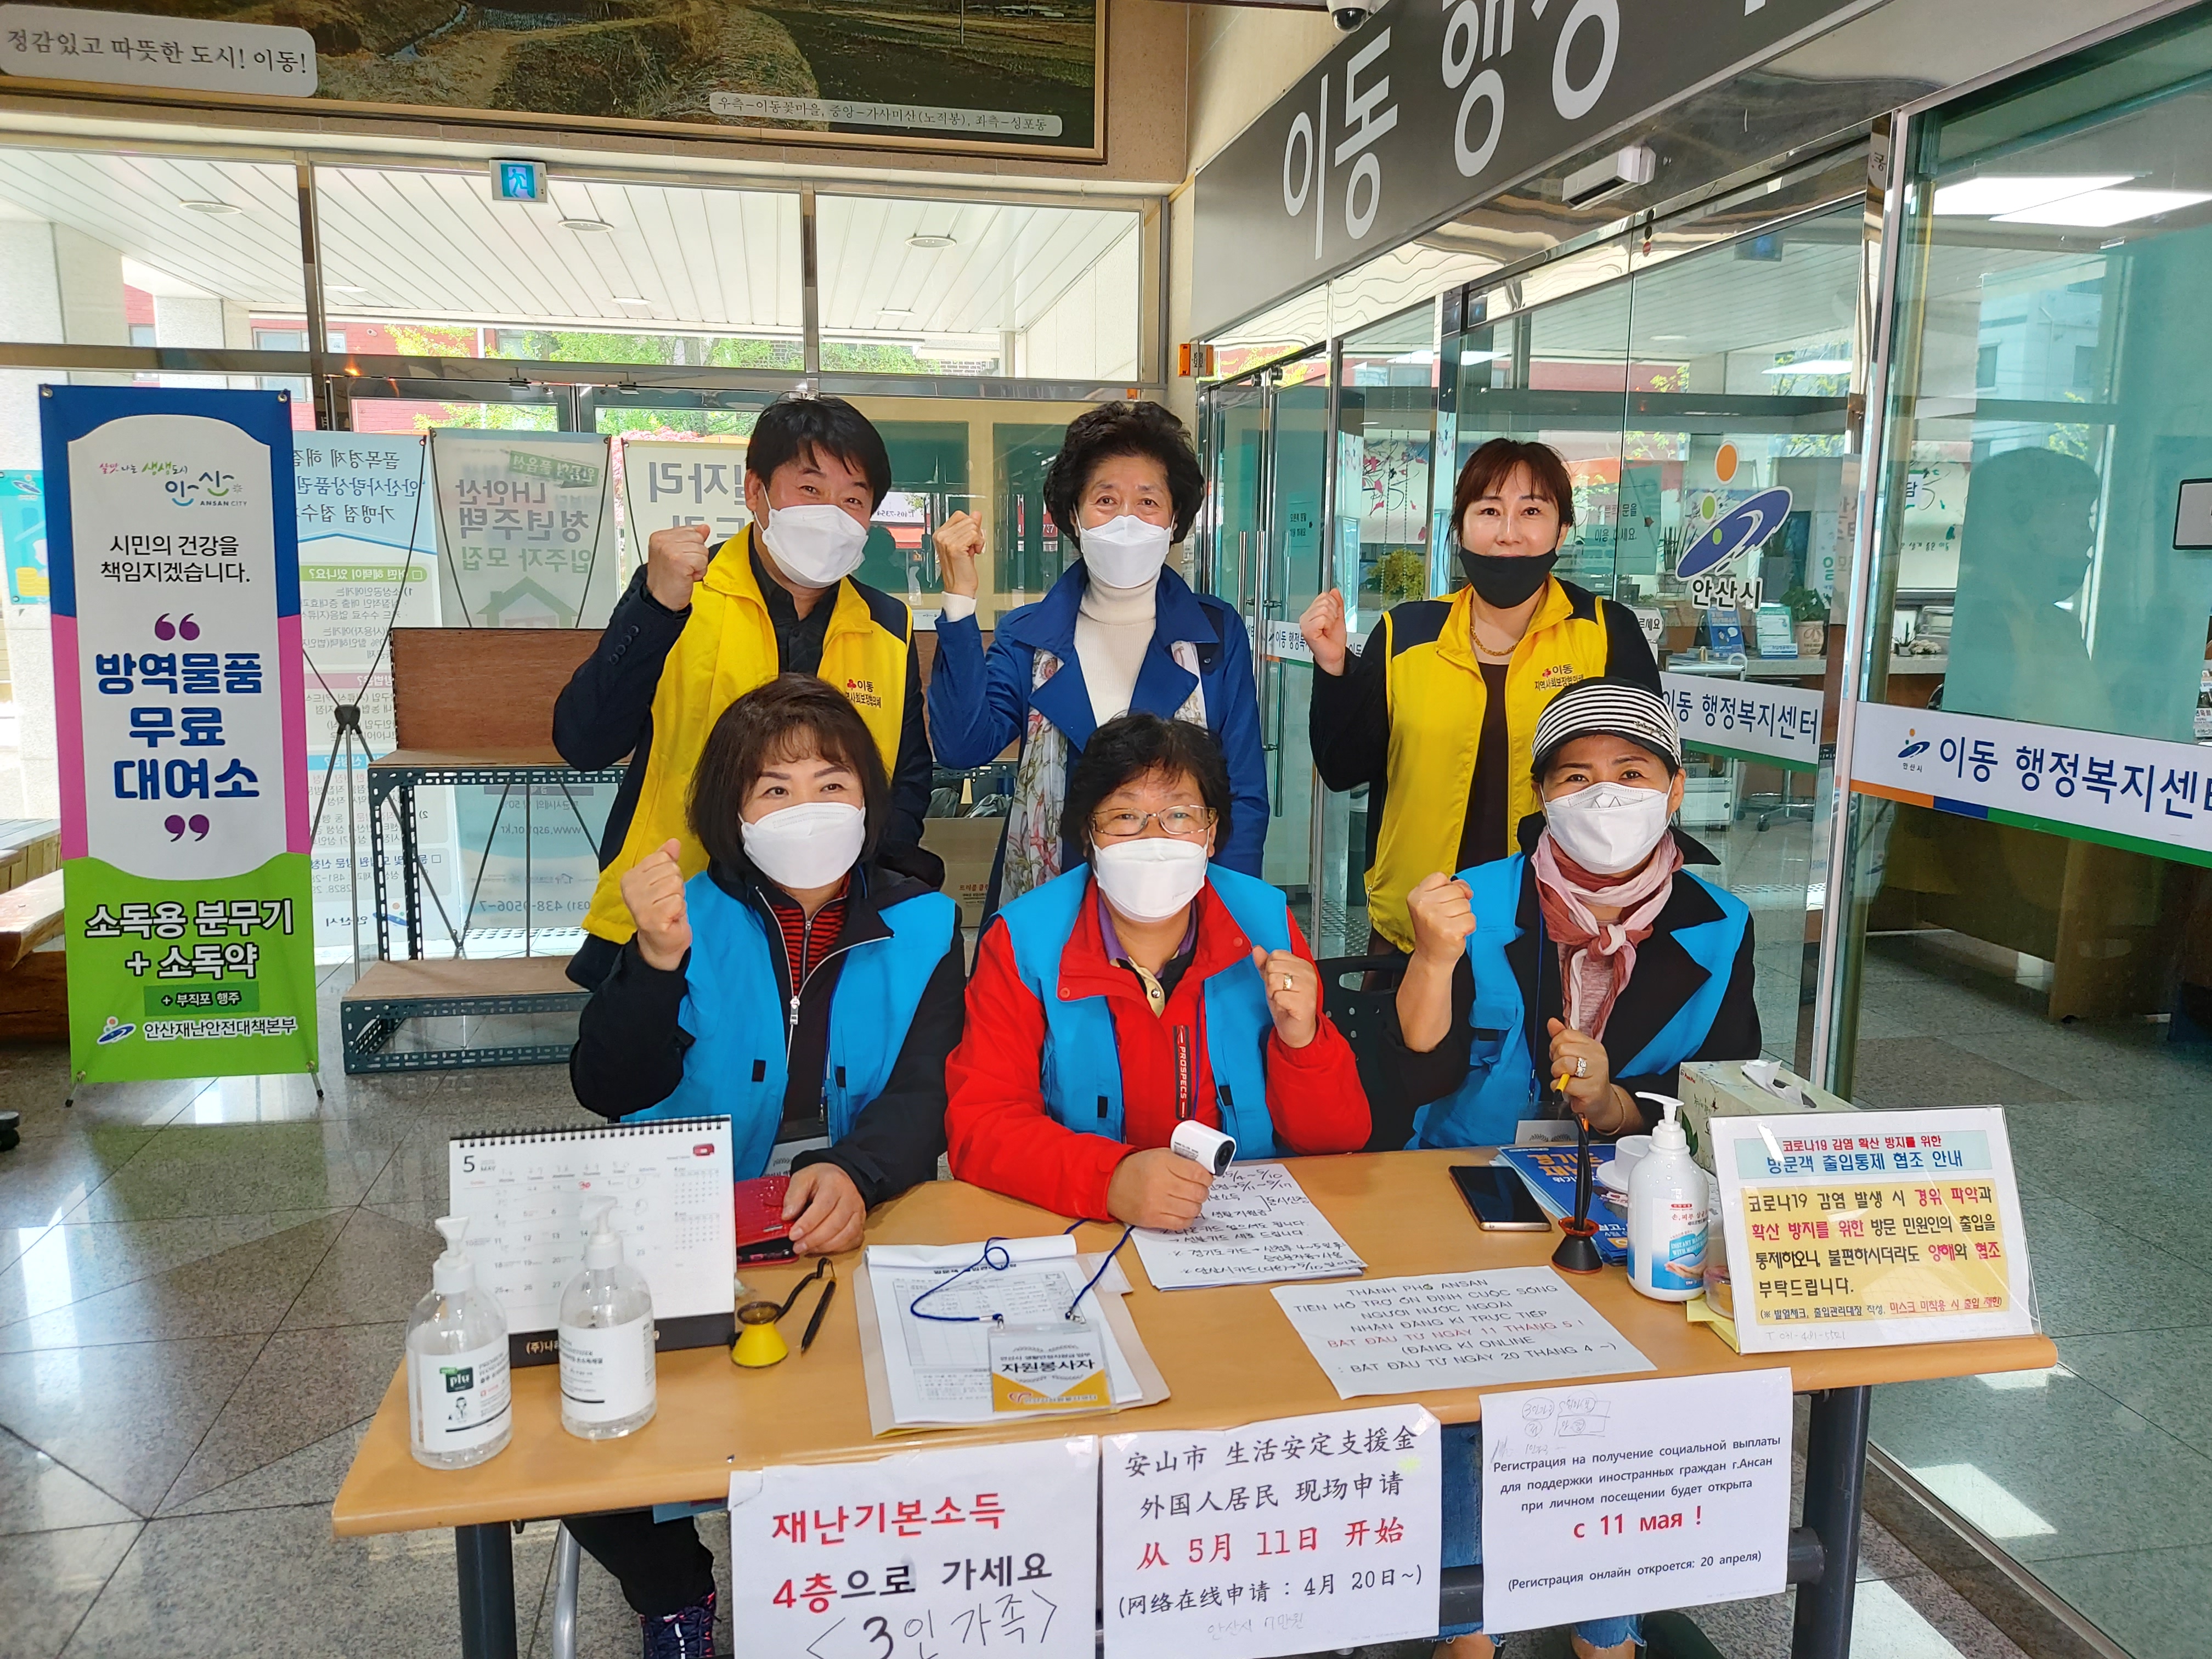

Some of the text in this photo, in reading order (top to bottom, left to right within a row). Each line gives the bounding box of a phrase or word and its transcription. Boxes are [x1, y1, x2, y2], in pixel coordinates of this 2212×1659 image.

[7, 30, 308, 75] 정감있고 따뜻한 도시! 이동!
[718, 96, 825, 117] 우측-이동꽃마을,
[975, 114, 1048, 132] 좌측-성포동
[1283, 26, 1398, 261] 이동
[165, 470, 236, 507] 안산
[110, 535, 240, 556] 시민의 건강을
[100, 561, 251, 583] 책임지겠습니다.
[1692, 579, 1762, 611] 안산시
[1276, 630, 1286, 648] 이동
[95, 652, 263, 695] 방역물품
[1552, 663, 1574, 675] 이동
[857, 680, 874, 693] 이동
[129, 707, 225, 748] 무료
[1663, 689, 1818, 745] 이동 행정복지센터
[1902, 761, 1922, 773] 안산시
[1940, 736, 1999, 783] 이동
[114, 758, 260, 800] 대여소
[85, 897, 294, 940] 소독용 분무기
[125, 943, 259, 980] + 소독약
[176, 992, 211, 1007] 부직포
[216, 991, 240, 1006] 행주
[143, 1018, 297, 1040] 안산재난안전대책본부
[1179, 1046, 1187, 1099] PROSPECS
[1782, 1135, 1942, 1152] 코로나19 감염 확산 방지를 위한
[462, 1155, 476, 1173] 5
[1767, 1150, 1963, 1174] 방문객 출입통제 협조 안내
[1748, 1186, 1993, 1212] 코로나19 감염 발생 시 경위 파악과
[1752, 1214, 1996, 1242] 확산 방지를 위한 방문 민원인의 출입을
[1827, 1245, 1920, 1267] 불편하시더라도
[1928, 1243, 1968, 1262] 양해와
[1975, 1241, 2002, 1260] 협조
[1441, 1279, 1488, 1289] ANSAN
[1758, 1278, 1854, 1298] 부탁드립니다.
[1813, 1305, 1863, 1318] 출입관리대장
[1920, 1299, 1946, 1312] 미착용
[1950, 1299, 1959, 1311] 시
[1964, 1297, 1980, 1310] 출입
[1479, 1335, 1536, 1348] ONLINE
[1480, 1327, 1497, 1335] 11
[1001, 1358, 1096, 1374] 자원봉사자
[1125, 1425, 1417, 1478] 安山市 生活安定支援金
[1493, 1436, 1781, 1473] Регистрация на получение социальной выплаты
[1500, 1457, 1773, 1495] для поддержки иностранных граждан г.Ансан
[1140, 1470, 1404, 1520] 外国人居民 现场申请
[1521, 1479, 1753, 1513] при личном посещении будет открыта
[771, 1492, 1006, 1545] 재난기본소득
[1600, 1513, 1625, 1536] 11
[1640, 1511, 1683, 1531] мая
[1695, 1505, 1703, 1526] !
[1136, 1516, 1404, 1571] 从 5月 11日 开始
[772, 1552, 1053, 1614] 4층으로 가세요
[1508, 1550, 1763, 1592] (Регистрация онлайн откроется: 20 апреля)
[1119, 1580, 1271, 1619] (网络在线申请
[1304, 1574, 1335, 1595] 4月
